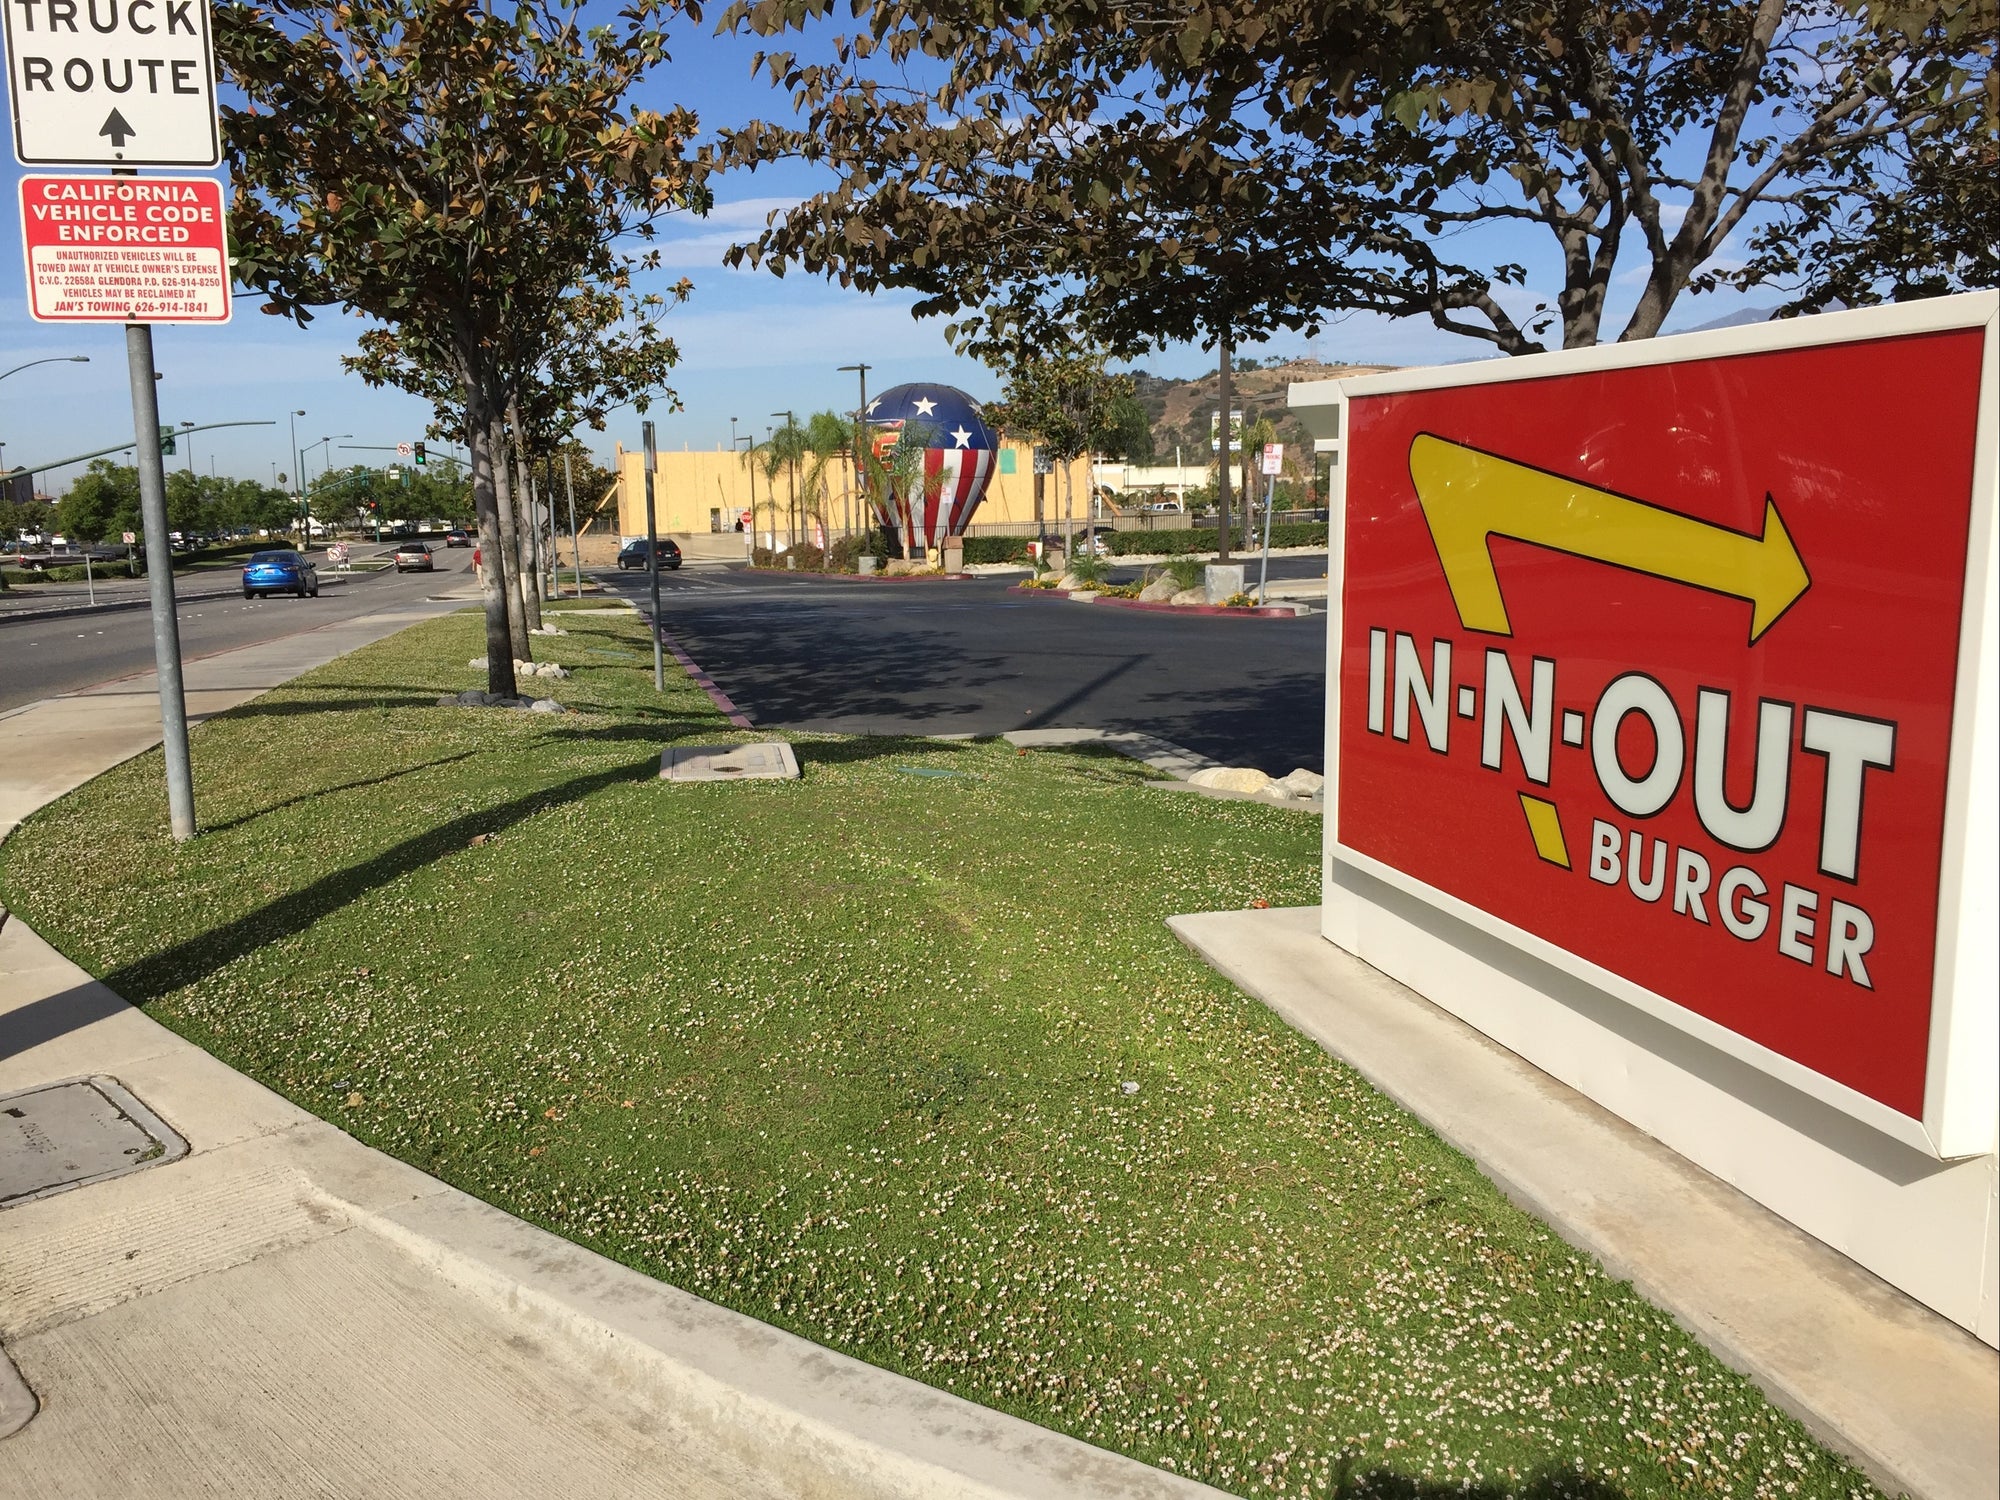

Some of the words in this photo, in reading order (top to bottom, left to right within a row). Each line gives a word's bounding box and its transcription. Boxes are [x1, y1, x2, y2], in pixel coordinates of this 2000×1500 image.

[14, 0, 197, 35] TRUCK
[23, 57, 199, 94] ROUTE
[43, 184, 199, 202] CALIFORNIA
[32, 204, 138, 222] VEHICLE
[146, 206, 214, 223] CODE
[59, 225, 189, 242] ENFORCED
[56, 251, 119, 260] UNAUTHORIZED
[121, 251, 161, 261] VEHICLES
[163, 252, 184, 261] WILL
[186, 252, 197, 261] BE
[37, 263, 66, 273] TOWED
[68, 263, 90, 273] AWAY
[93, 264, 103, 273] AT
[105, 264, 140, 273] VEHICLE
[142, 264, 180, 274] OWNER'S
[182, 265, 218, 274] EXPENSE
[39, 276, 63, 285] C.V.C.
[64, 276, 95, 285] 22658A
[98, 276, 142, 286] GLENDORA
[144, 277, 160, 286] P.D.
[162, 278, 220, 287] 626-914-8250
[63, 288, 103, 298] VEHICLES
[105, 289, 122, 298] MAY
[124, 289, 135, 298] BE
[137, 289, 184, 298] RECLAIMED
[186, 290, 196, 299] AT
[54, 301, 84, 312] JAN'S
[87, 301, 131, 312] TOWING
[134, 302, 208, 313] 626-914-1841
[1366, 626, 1898, 886] IN-N-OUT
[1589, 817, 1876, 991] BURGER
